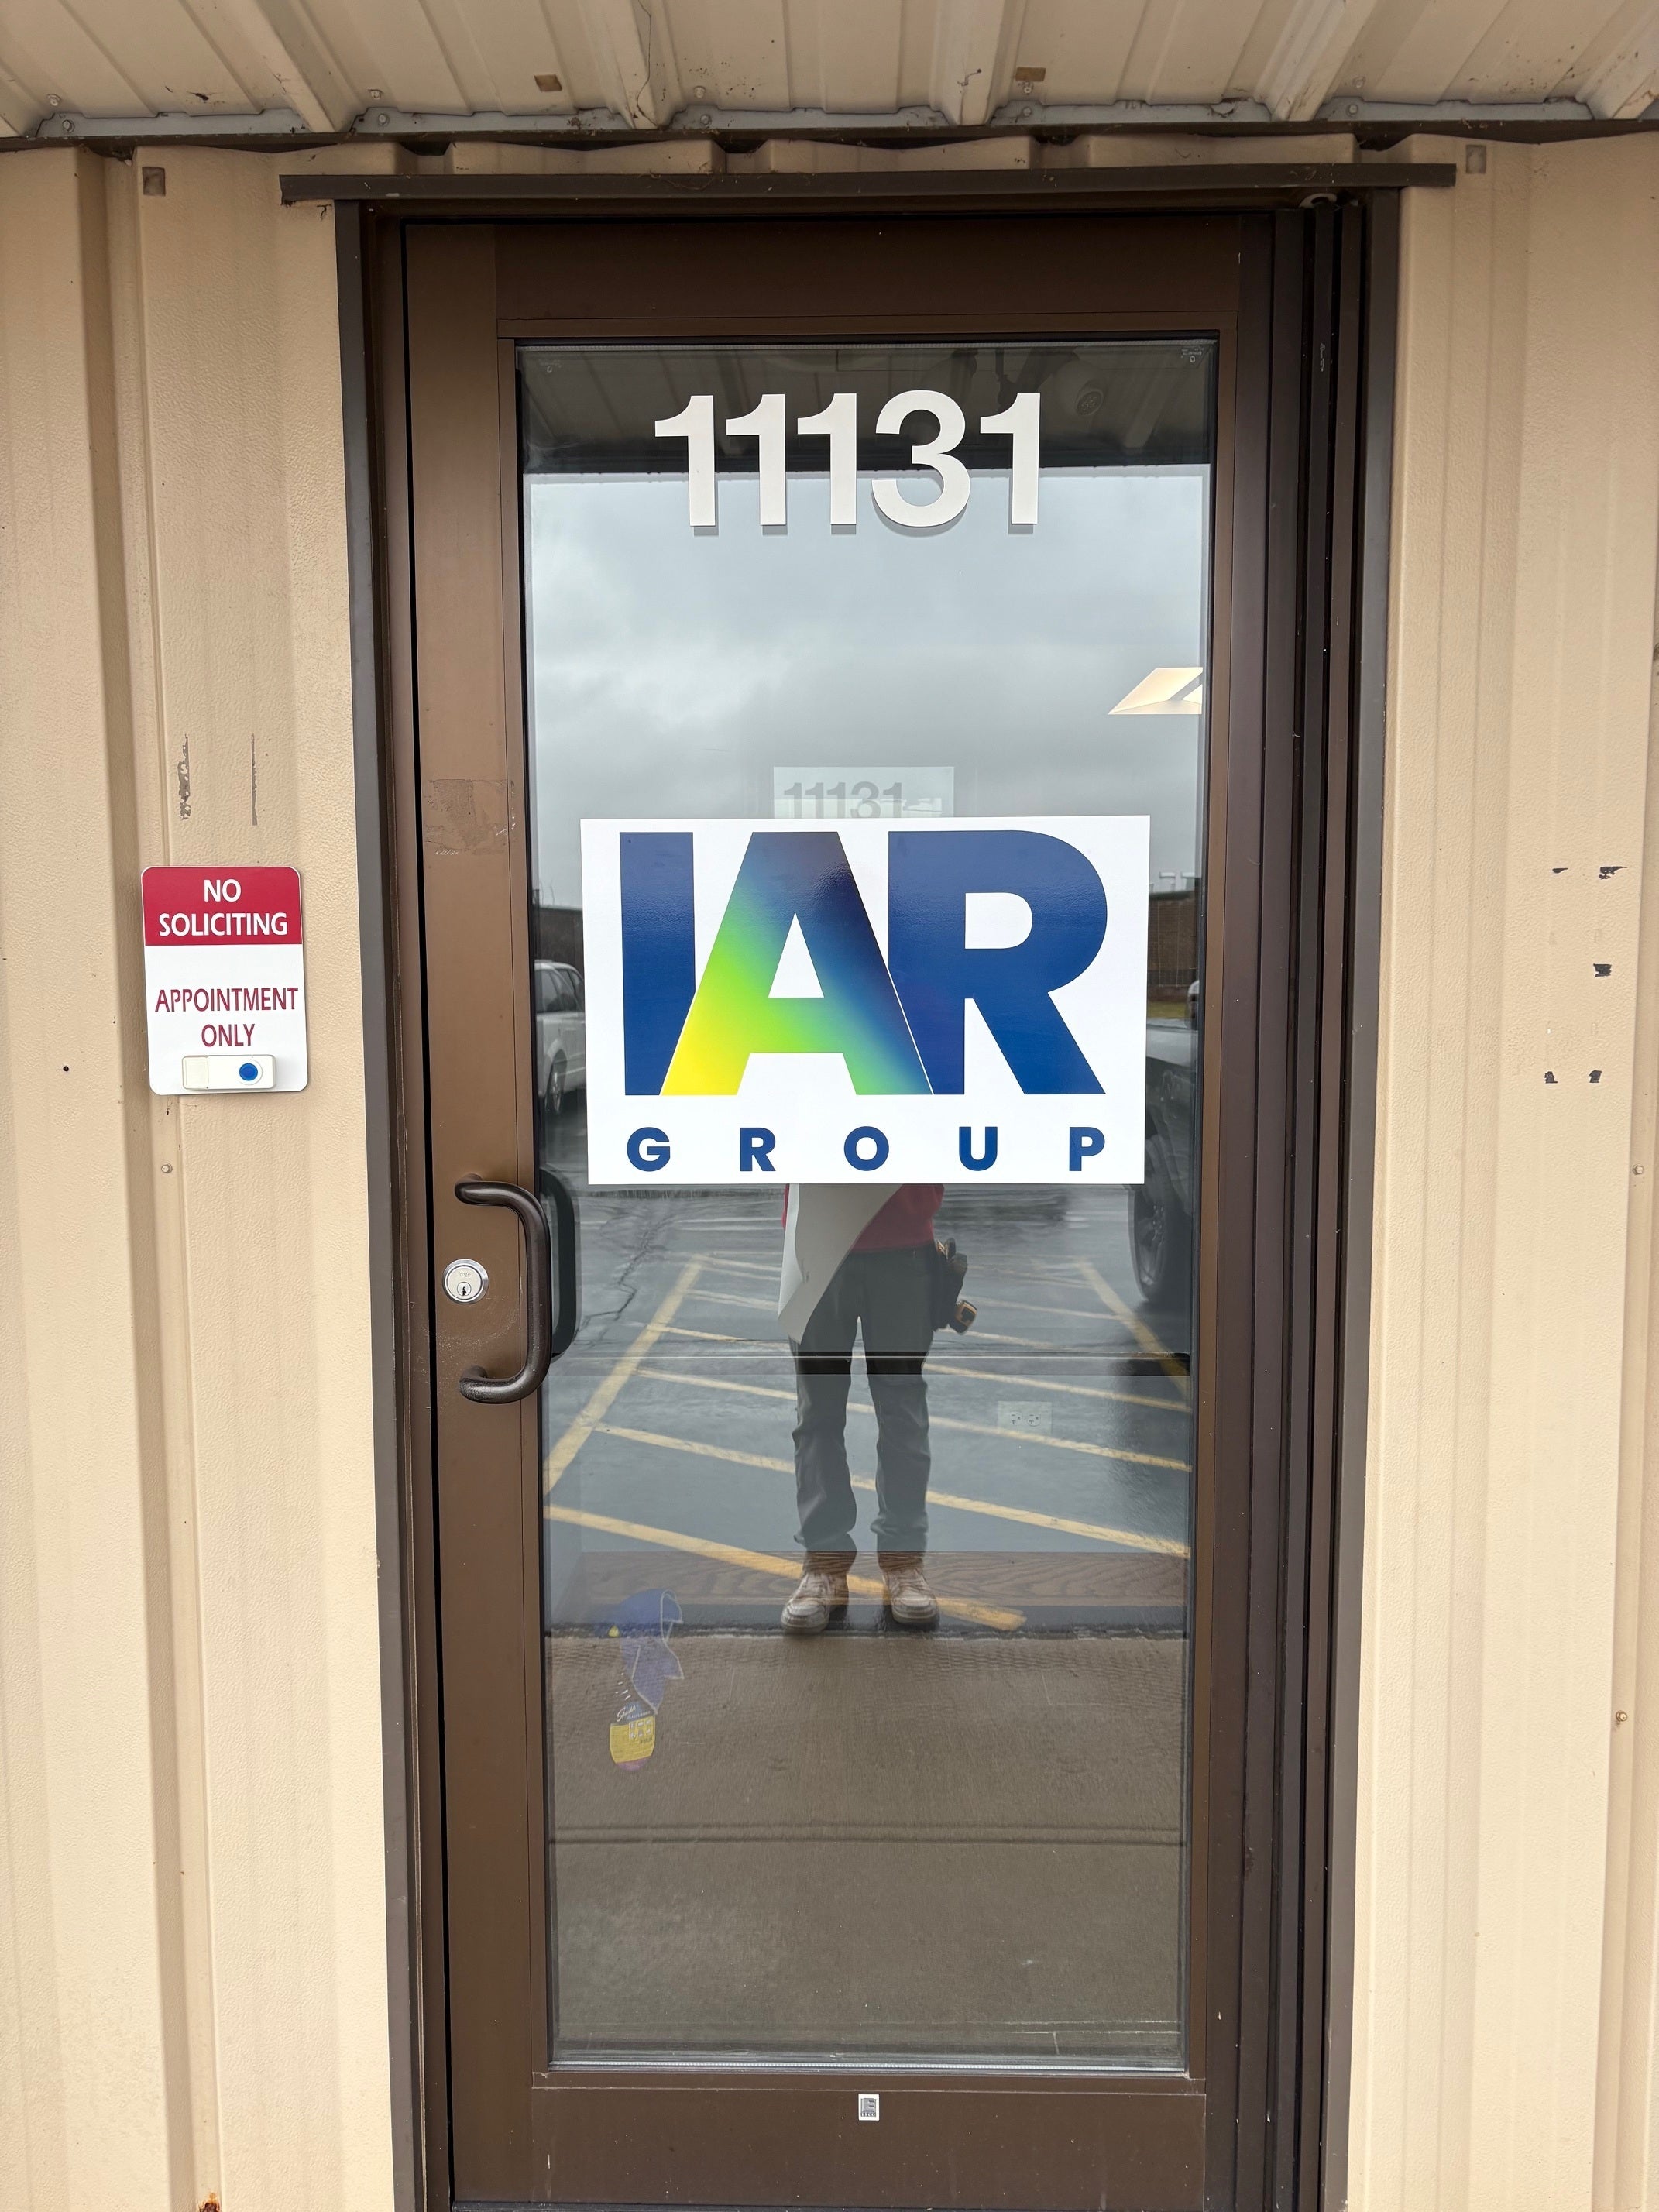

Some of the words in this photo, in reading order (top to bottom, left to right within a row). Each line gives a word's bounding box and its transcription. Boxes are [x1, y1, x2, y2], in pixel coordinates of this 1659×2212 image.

[654, 390, 1041, 527] 11131
[784, 781, 903, 818] 11131
[204, 879, 241, 902] NO
[159, 912, 288, 936] SOLICITING
[620, 830, 1108, 1096] IAR
[155, 988, 298, 1012] APPOINTMENT
[201, 1024, 255, 1047] ONLY
[626, 1126, 1106, 1173] GROUP
